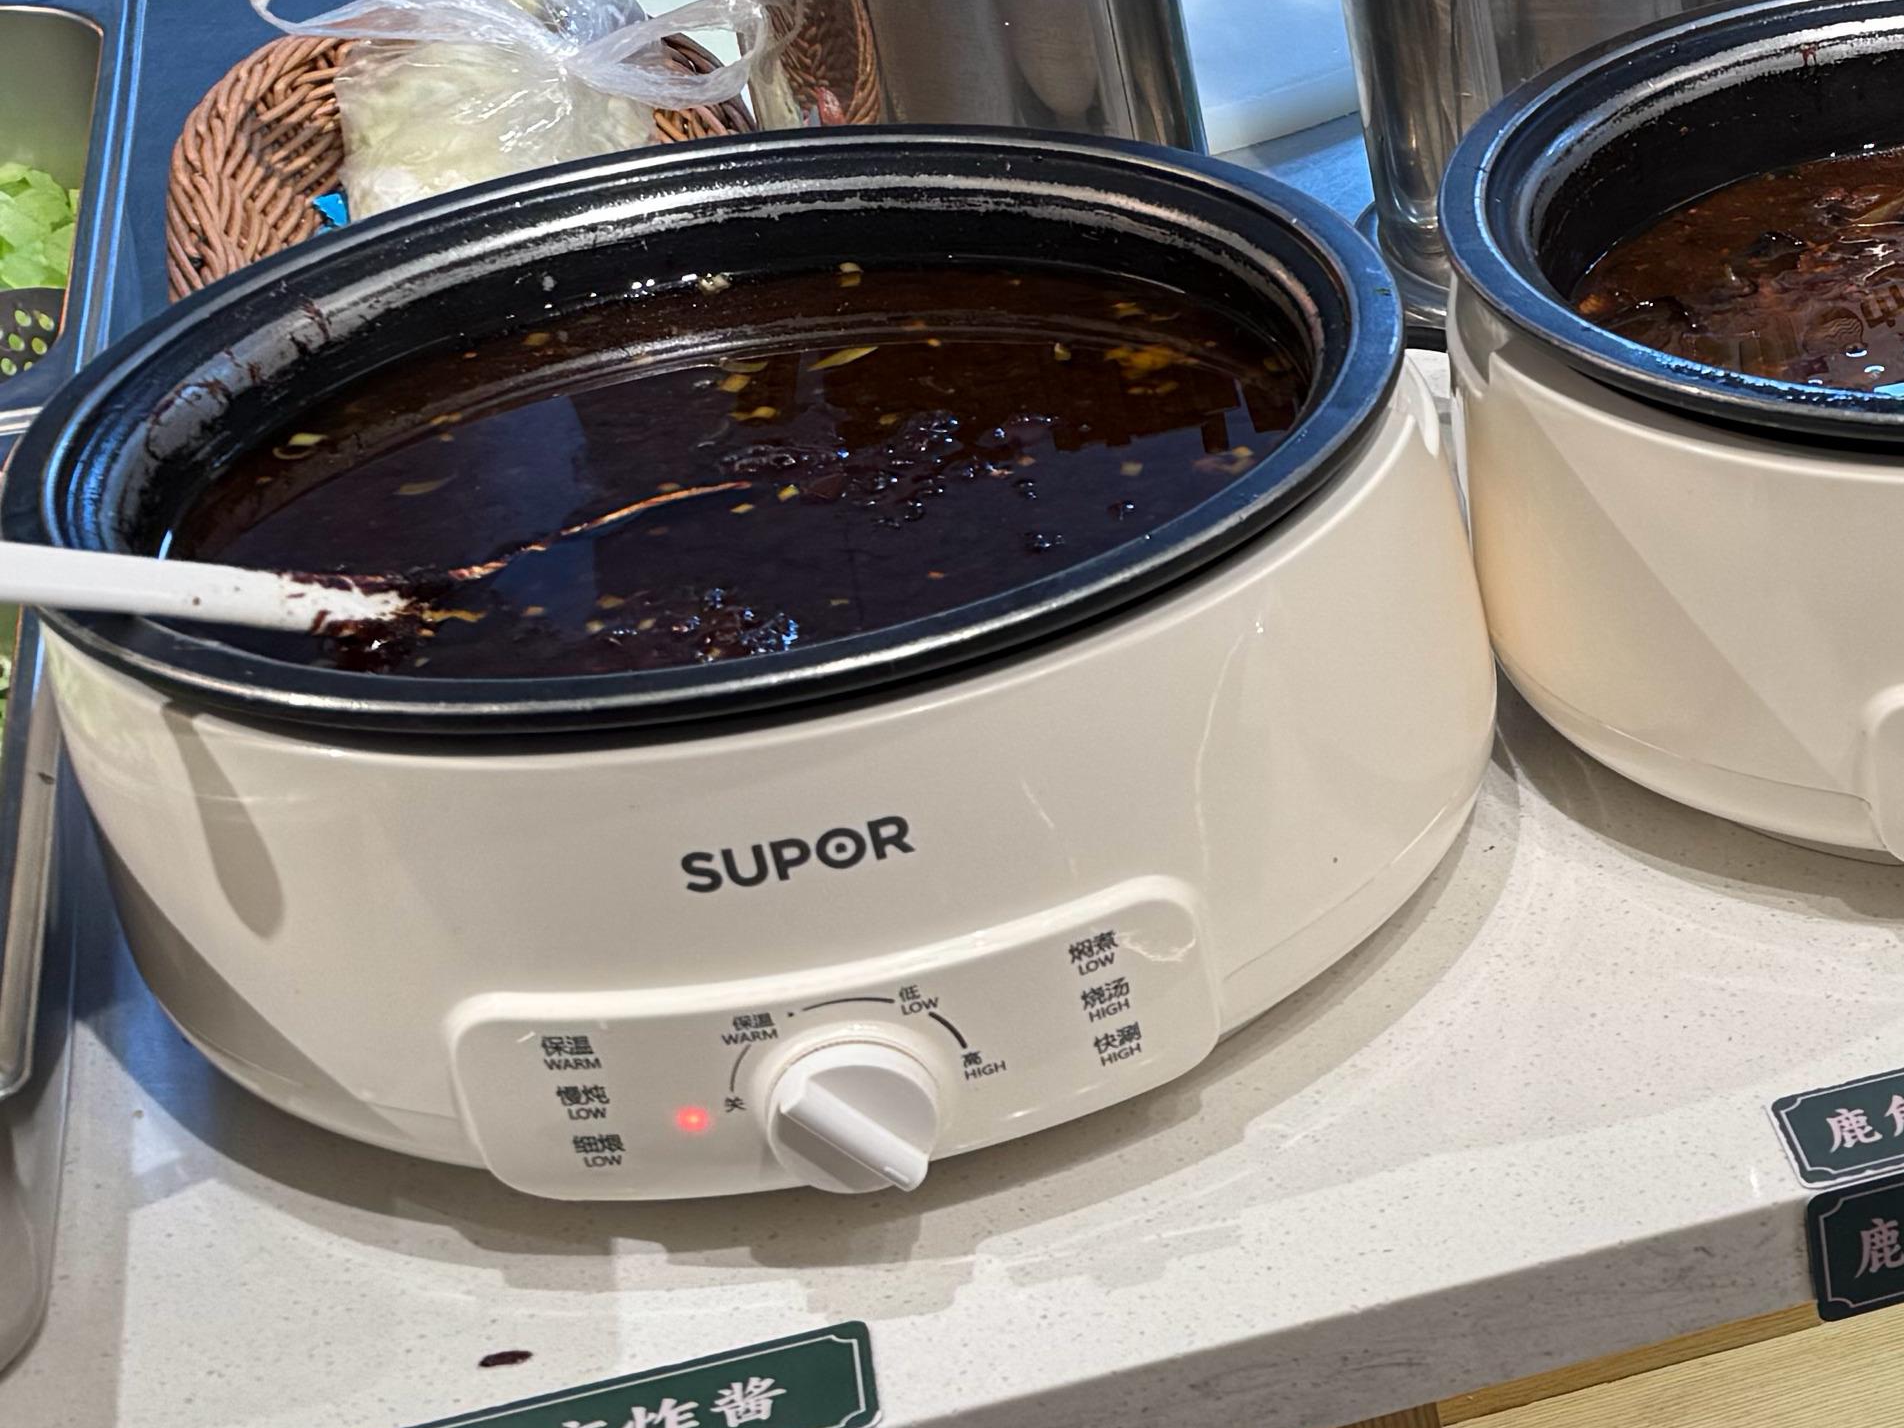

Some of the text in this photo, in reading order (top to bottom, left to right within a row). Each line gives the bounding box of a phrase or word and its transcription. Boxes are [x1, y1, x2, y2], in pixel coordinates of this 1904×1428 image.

[680, 815, 915, 893] SUPOR
[1078, 952, 1115, 976] LOW
[901, 996, 940, 1016] LOW
[1088, 998, 1130, 1023] HIGH
[732, 1012, 775, 1031] 保温
[541, 1035, 594, 1057] 保温
[721, 1028, 778, 1047] WARM
[543, 1057, 602, 1071] WARM
[1100, 1042, 1142, 1067] HIGH
[964, 1060, 1007, 1081] HIGH
[568, 1107, 607, 1121] LOW
[584, 1155, 623, 1169] LOW
